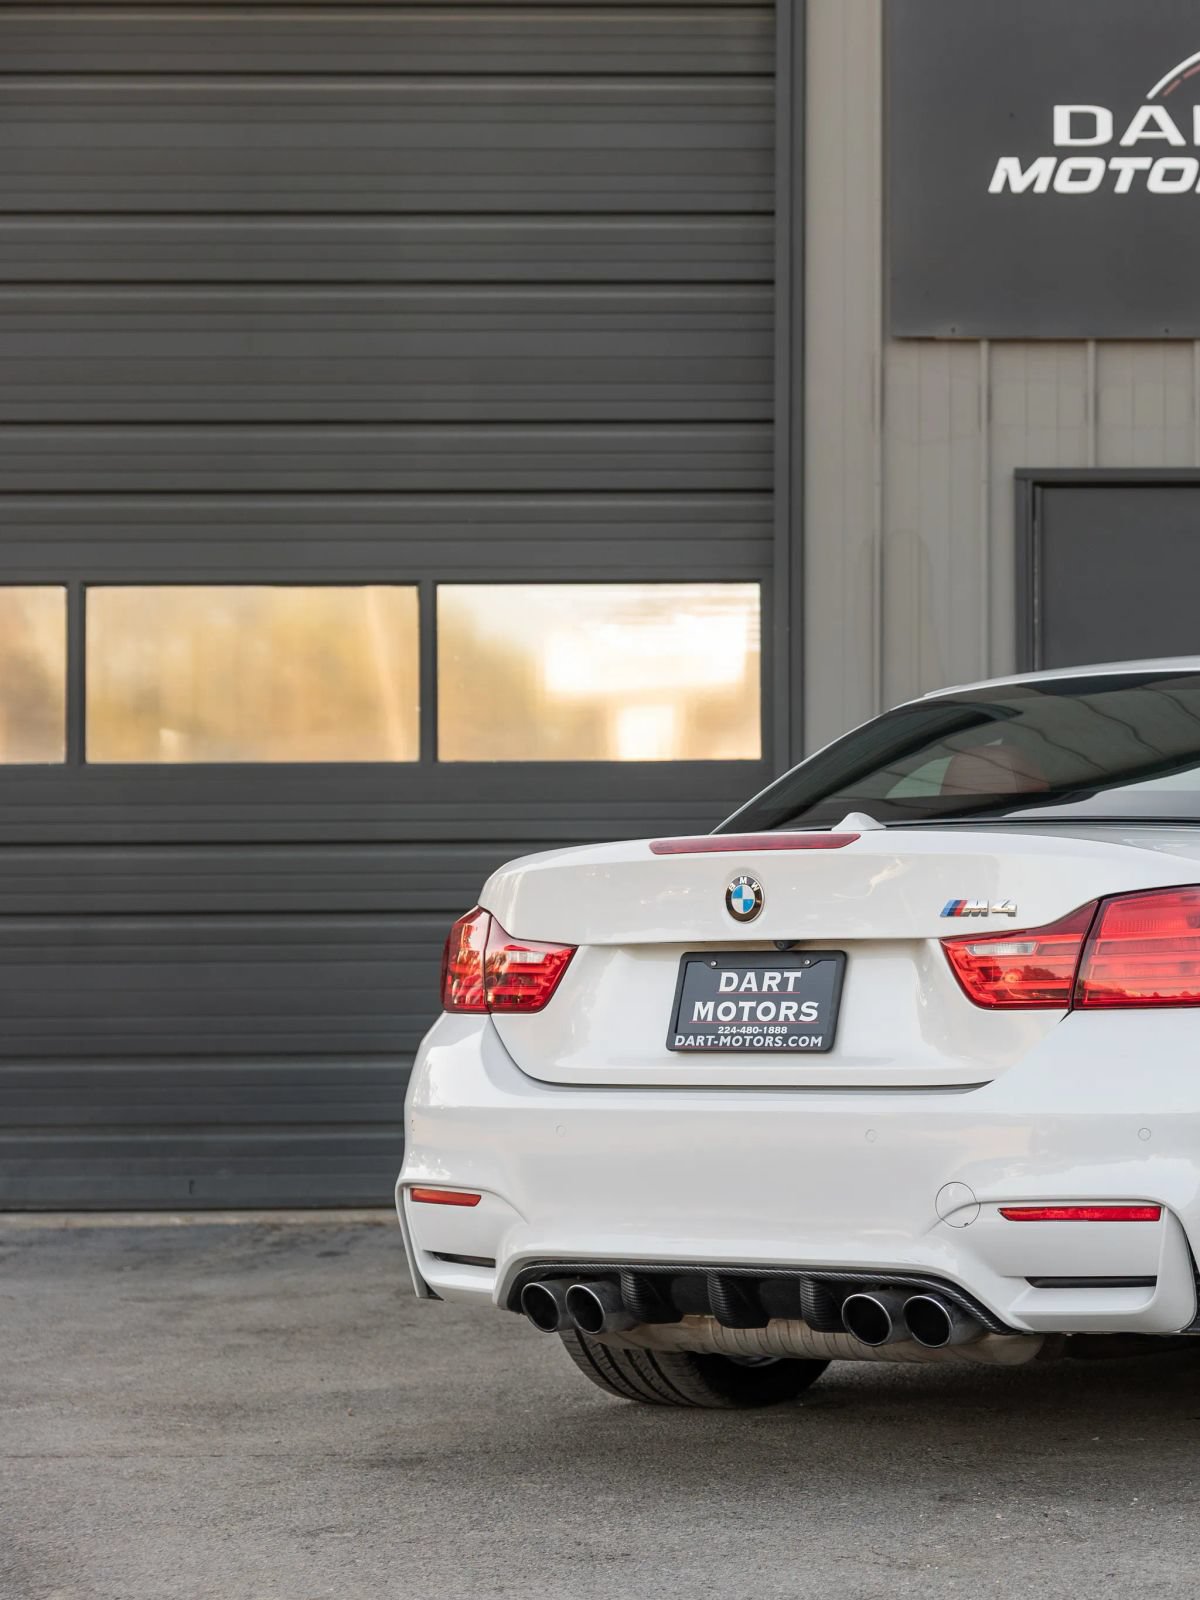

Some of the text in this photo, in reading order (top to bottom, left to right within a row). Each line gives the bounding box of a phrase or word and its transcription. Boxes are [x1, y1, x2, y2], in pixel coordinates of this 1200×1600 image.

[728, 876, 761, 892] BMW
[961, 899, 1017, 917] M4
[718, 971, 802, 992] DART
[692, 1001, 819, 1022] MOTORS
[717, 1026, 788, 1034] 224-480-1888
[675, 1035, 823, 1047] DART-MOTORS.COM
